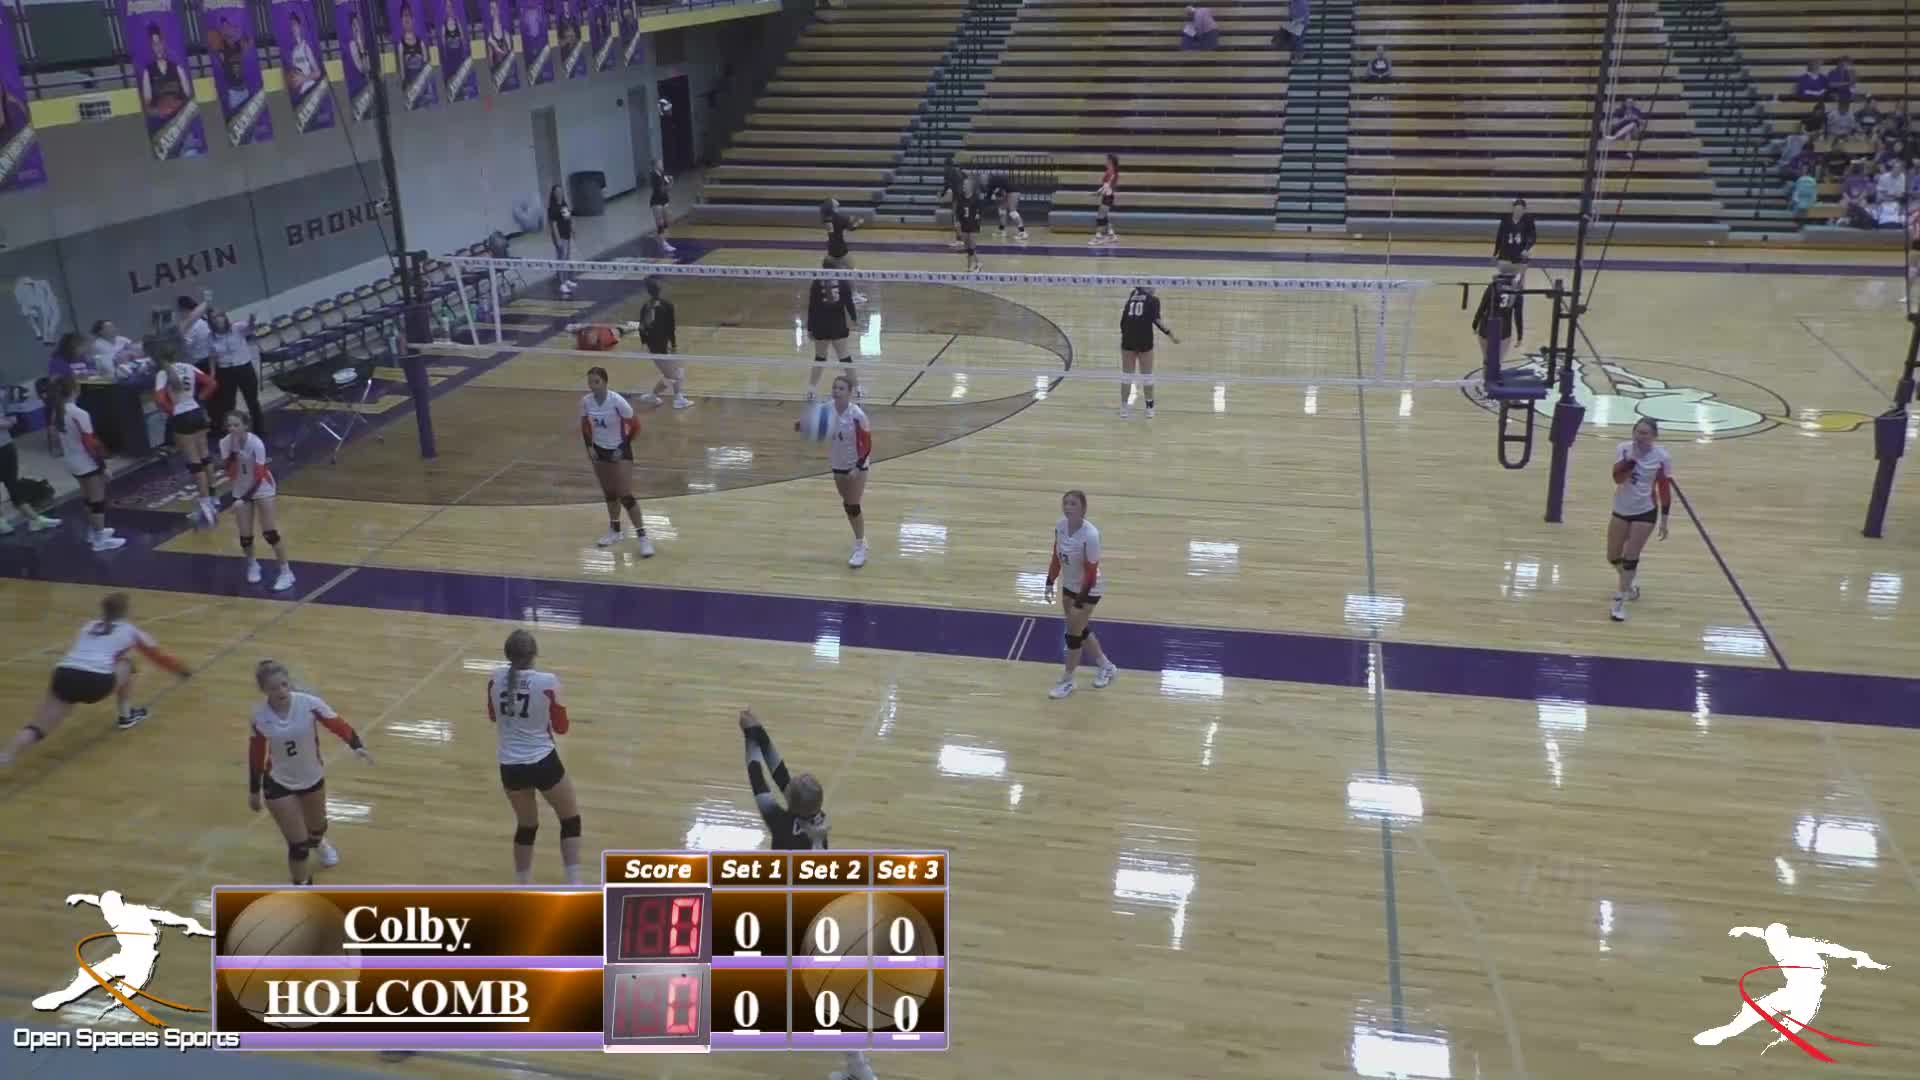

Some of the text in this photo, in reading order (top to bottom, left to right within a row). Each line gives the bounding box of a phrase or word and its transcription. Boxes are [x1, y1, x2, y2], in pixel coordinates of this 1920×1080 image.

[129, 244, 237, 294] LAKIN
[1128, 302, 1144, 316] 10
[284, 740, 297, 757] 2
